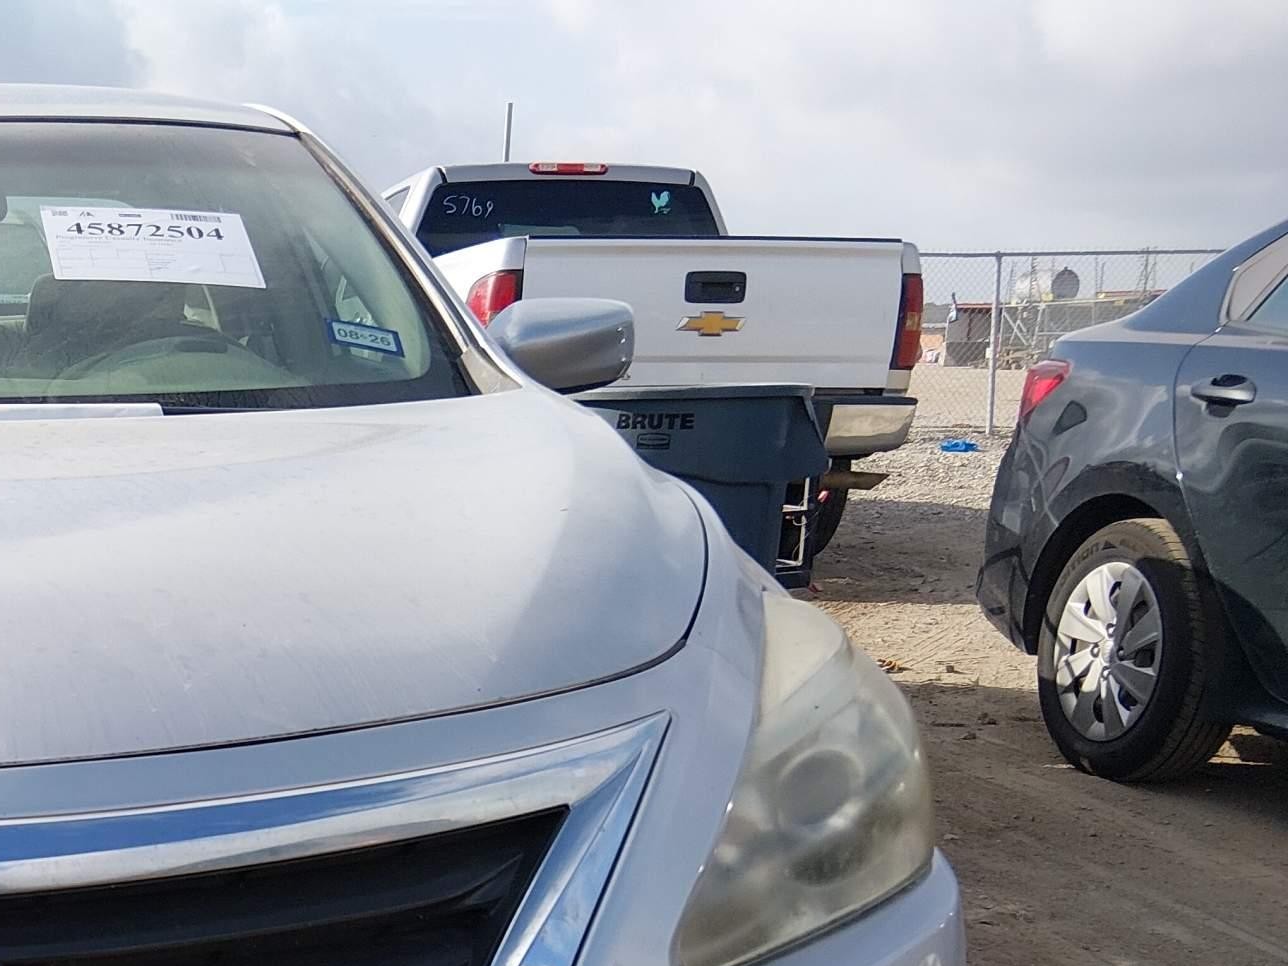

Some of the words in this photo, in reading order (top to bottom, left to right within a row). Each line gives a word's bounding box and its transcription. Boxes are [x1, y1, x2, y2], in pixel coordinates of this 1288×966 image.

[441, 194, 495, 219] 5769
[66, 222, 225, 241] 45872504
[616, 413, 695, 430] BRUTE
